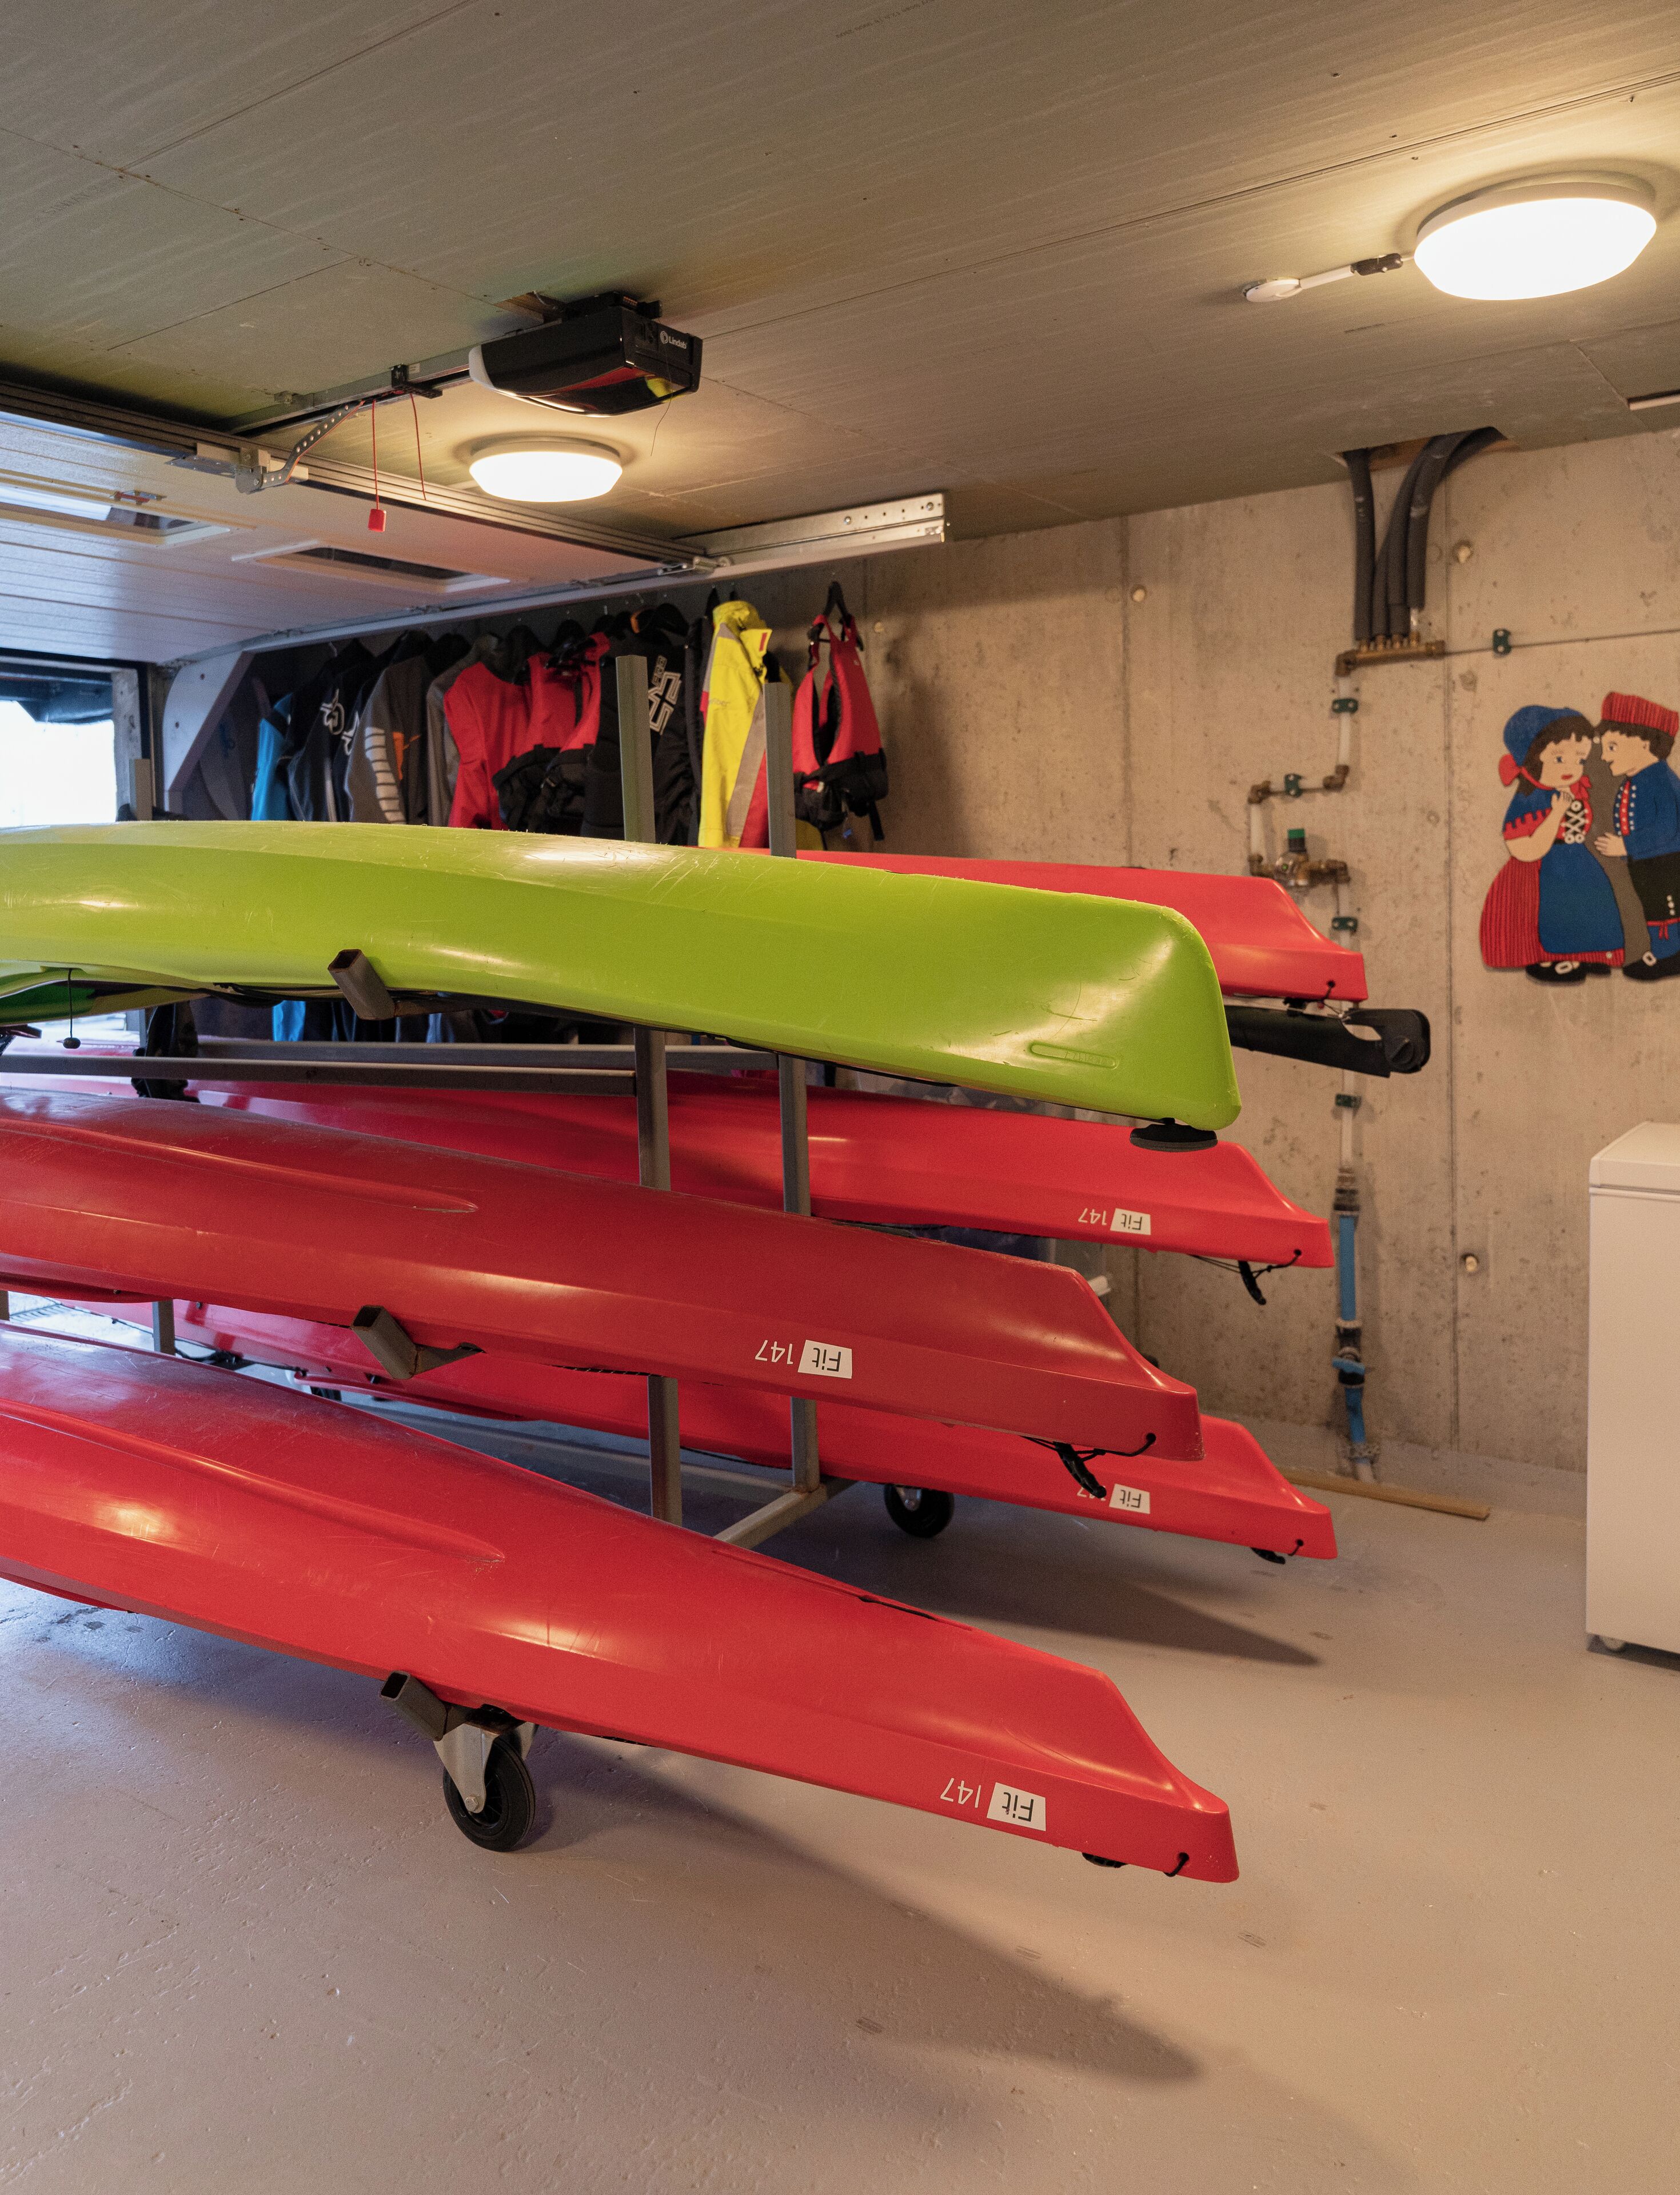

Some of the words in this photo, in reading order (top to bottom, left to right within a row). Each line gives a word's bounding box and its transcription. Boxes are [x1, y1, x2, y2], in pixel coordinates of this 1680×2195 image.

[668, 336, 687, 349] Lindab
[1078, 1207, 1108, 1226] 147
[1120, 1213, 1143, 1231] Fit
[755, 1339, 794, 1365] 147
[812, 1347, 841, 1372] Fit
[1119, 1488, 1142, 1508] Fit
[940, 1777, 981, 1809] 147
[1001, 1791, 1034, 1822] Fit
